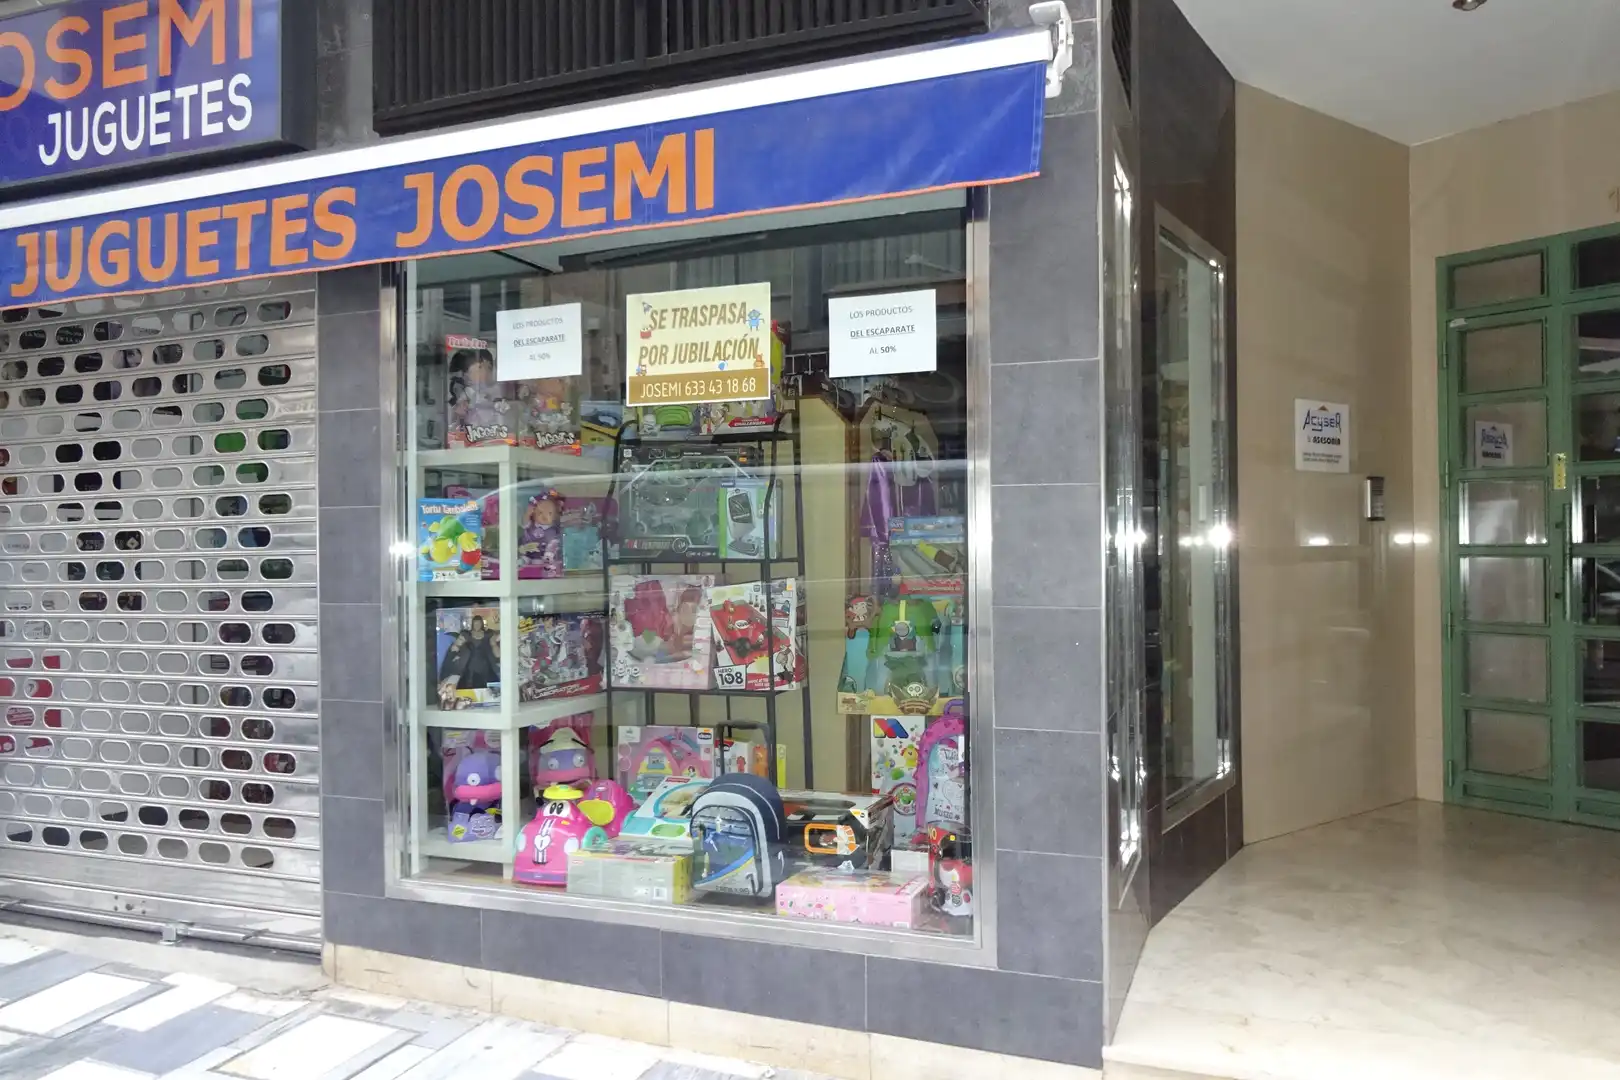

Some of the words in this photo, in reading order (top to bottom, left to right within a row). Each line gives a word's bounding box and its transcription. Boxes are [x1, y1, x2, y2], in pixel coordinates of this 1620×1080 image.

[38, 73, 252, 166] JUGUETES
[10, 186, 357, 298] JUGUETES
[395, 127, 715, 248] JOSEMI
[649, 308, 668, 331] SE
[671, 301, 748, 329] TRASPASA
[849, 311, 864, 320] LOS
[865, 305, 914, 317] PRODUCTOS
[850, 329, 865, 338] DEL
[866, 324, 916, 337] ESCAPARATE
[639, 344, 669, 367] POR
[670, 333, 760, 365] JUBILACIÓN
[869, 347, 878, 355] AL
[880, 345, 897, 354] 50%
[641, 381, 682, 399] JOSEMI
[685, 380, 705, 396] 633
[709, 379, 723, 394] 43
[727, 378, 739, 393] 18
[742, 376, 756, 392] 68
